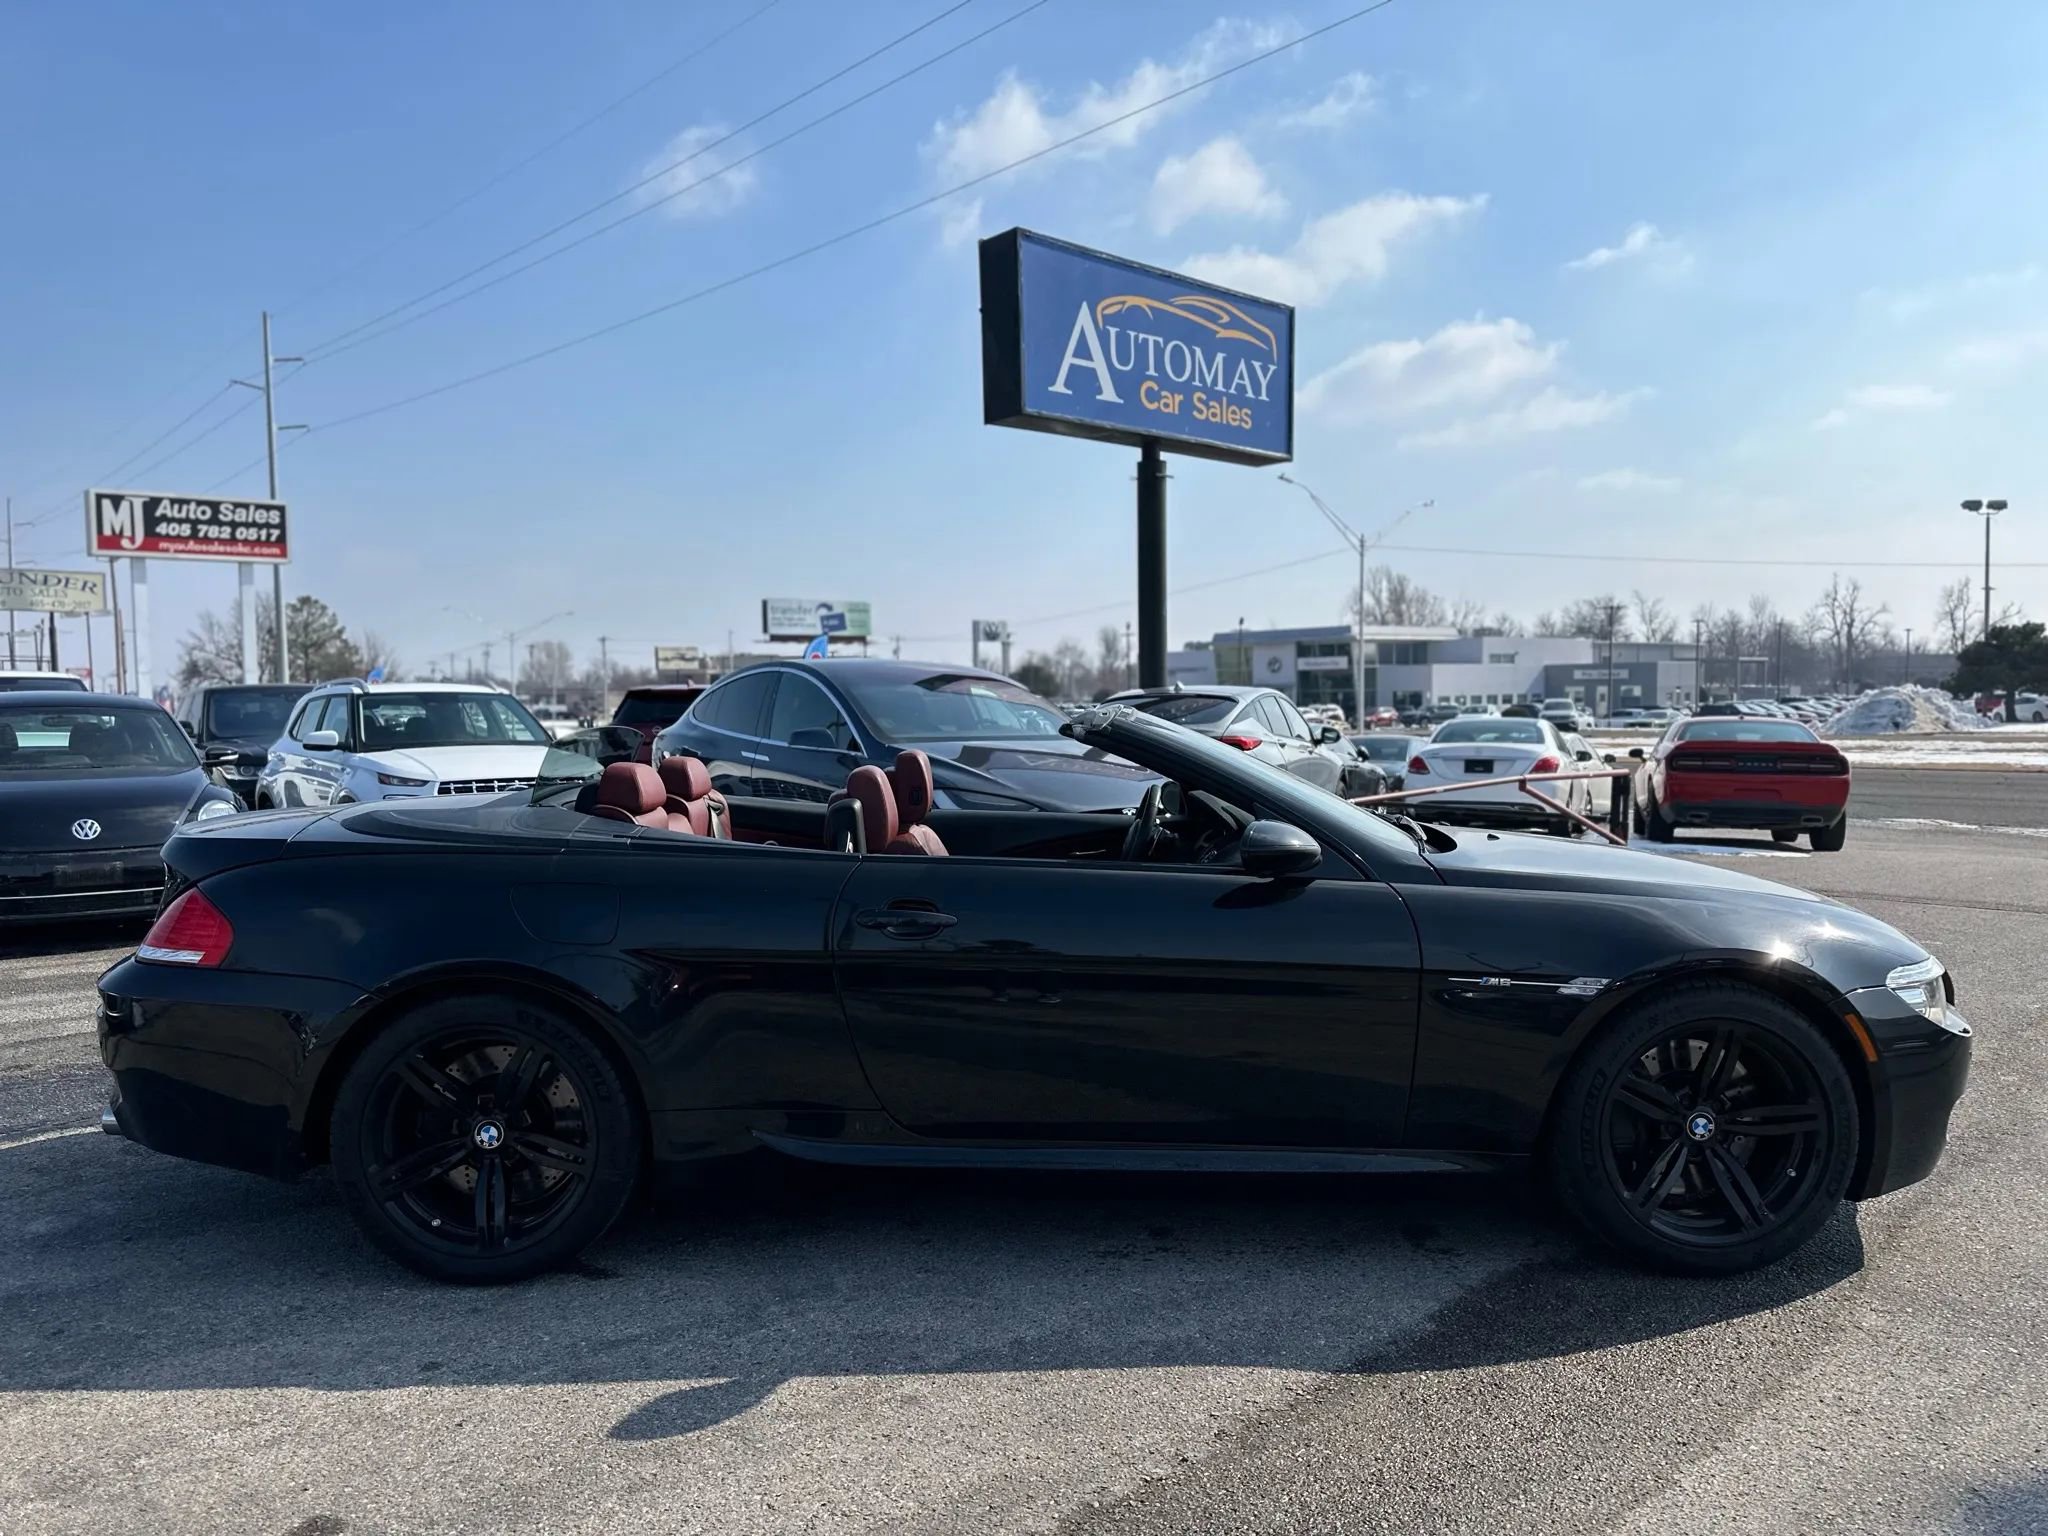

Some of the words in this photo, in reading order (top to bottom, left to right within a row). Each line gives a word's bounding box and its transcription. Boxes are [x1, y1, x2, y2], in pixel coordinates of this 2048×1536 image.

[1048, 300, 1277, 404] AUTOMAY
[1139, 380, 1184, 415] Car
[1193, 391, 1253, 430] Sales
[101, 496, 150, 549] MJ
[154, 499, 212, 521] Auto
[218, 503, 281, 524] Sales
[155, 522, 191, 537] 405
[197, 525, 232, 540] 782
[235, 527, 281, 542] 0517
[30, 588, 68, 599] SALES
